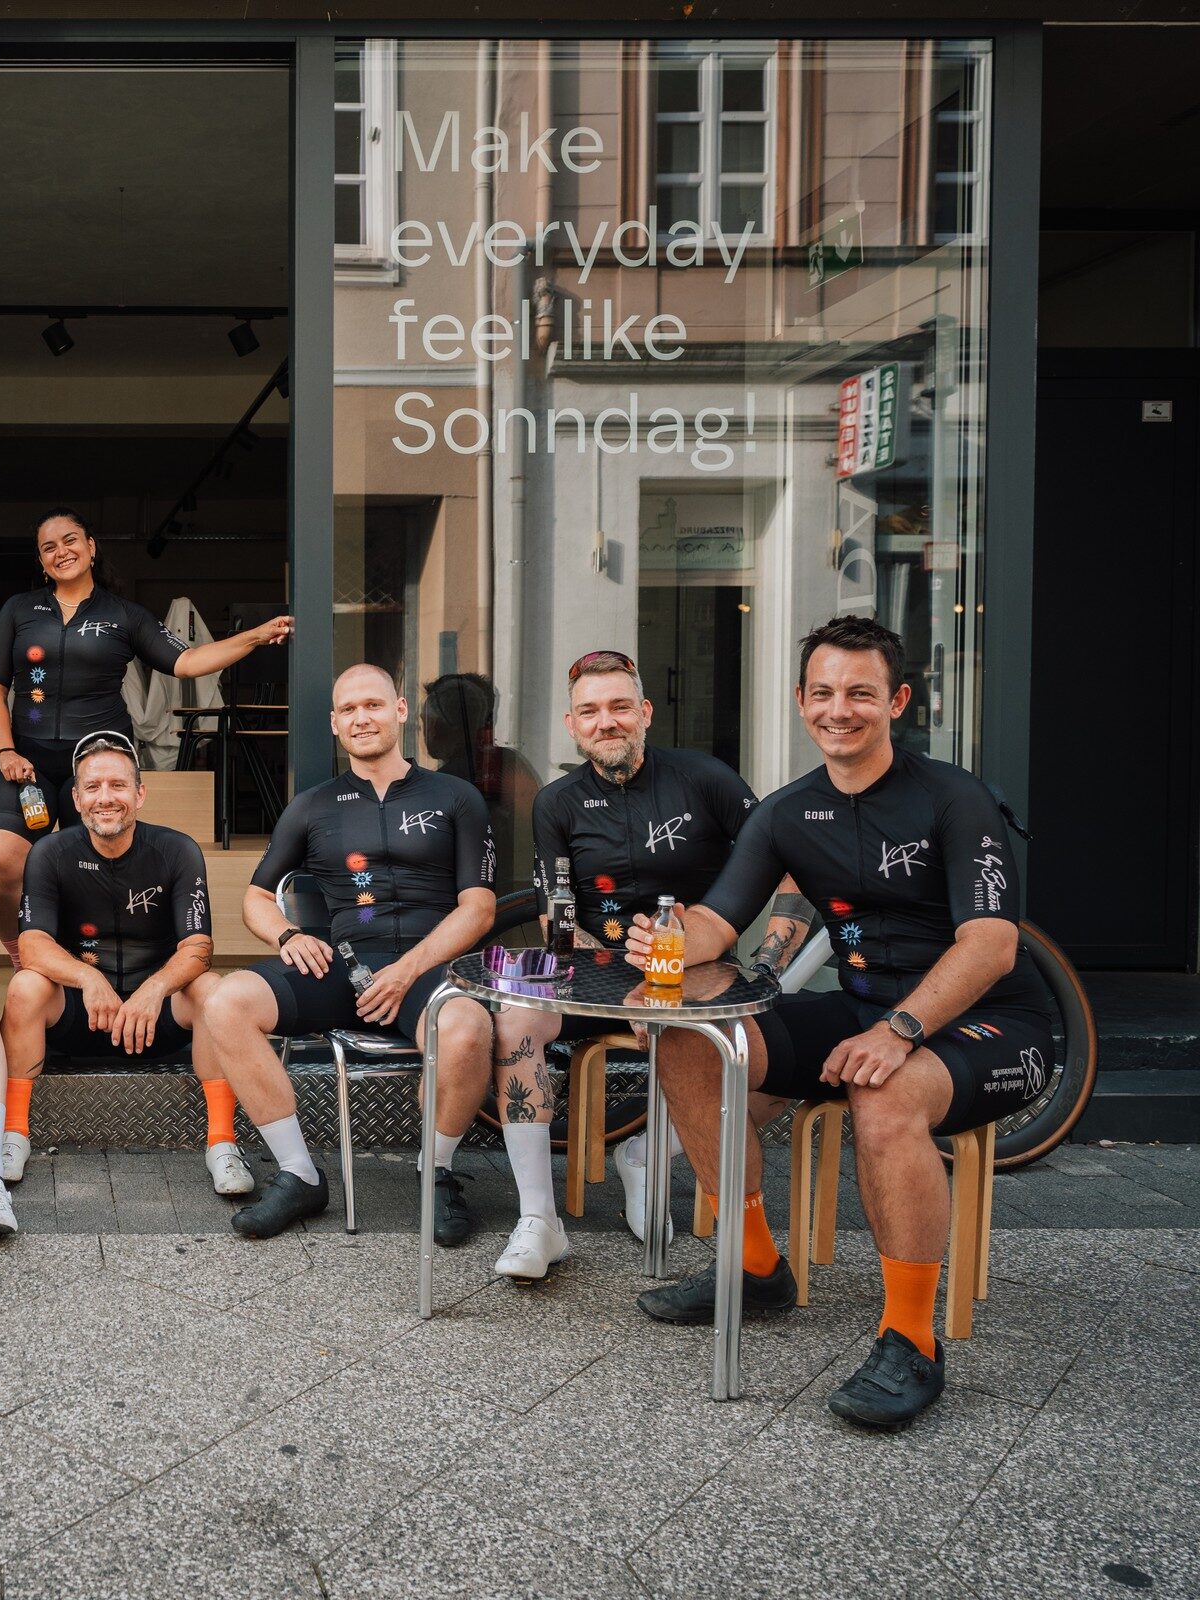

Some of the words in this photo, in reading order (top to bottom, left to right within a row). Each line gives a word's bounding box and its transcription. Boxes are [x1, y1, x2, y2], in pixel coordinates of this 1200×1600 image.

[394, 110, 604, 174] Make
[389, 205, 755, 284] everyday
[389, 298, 531, 362] feel
[564, 298, 688, 361] like
[392, 391, 757, 472] Sonndag!
